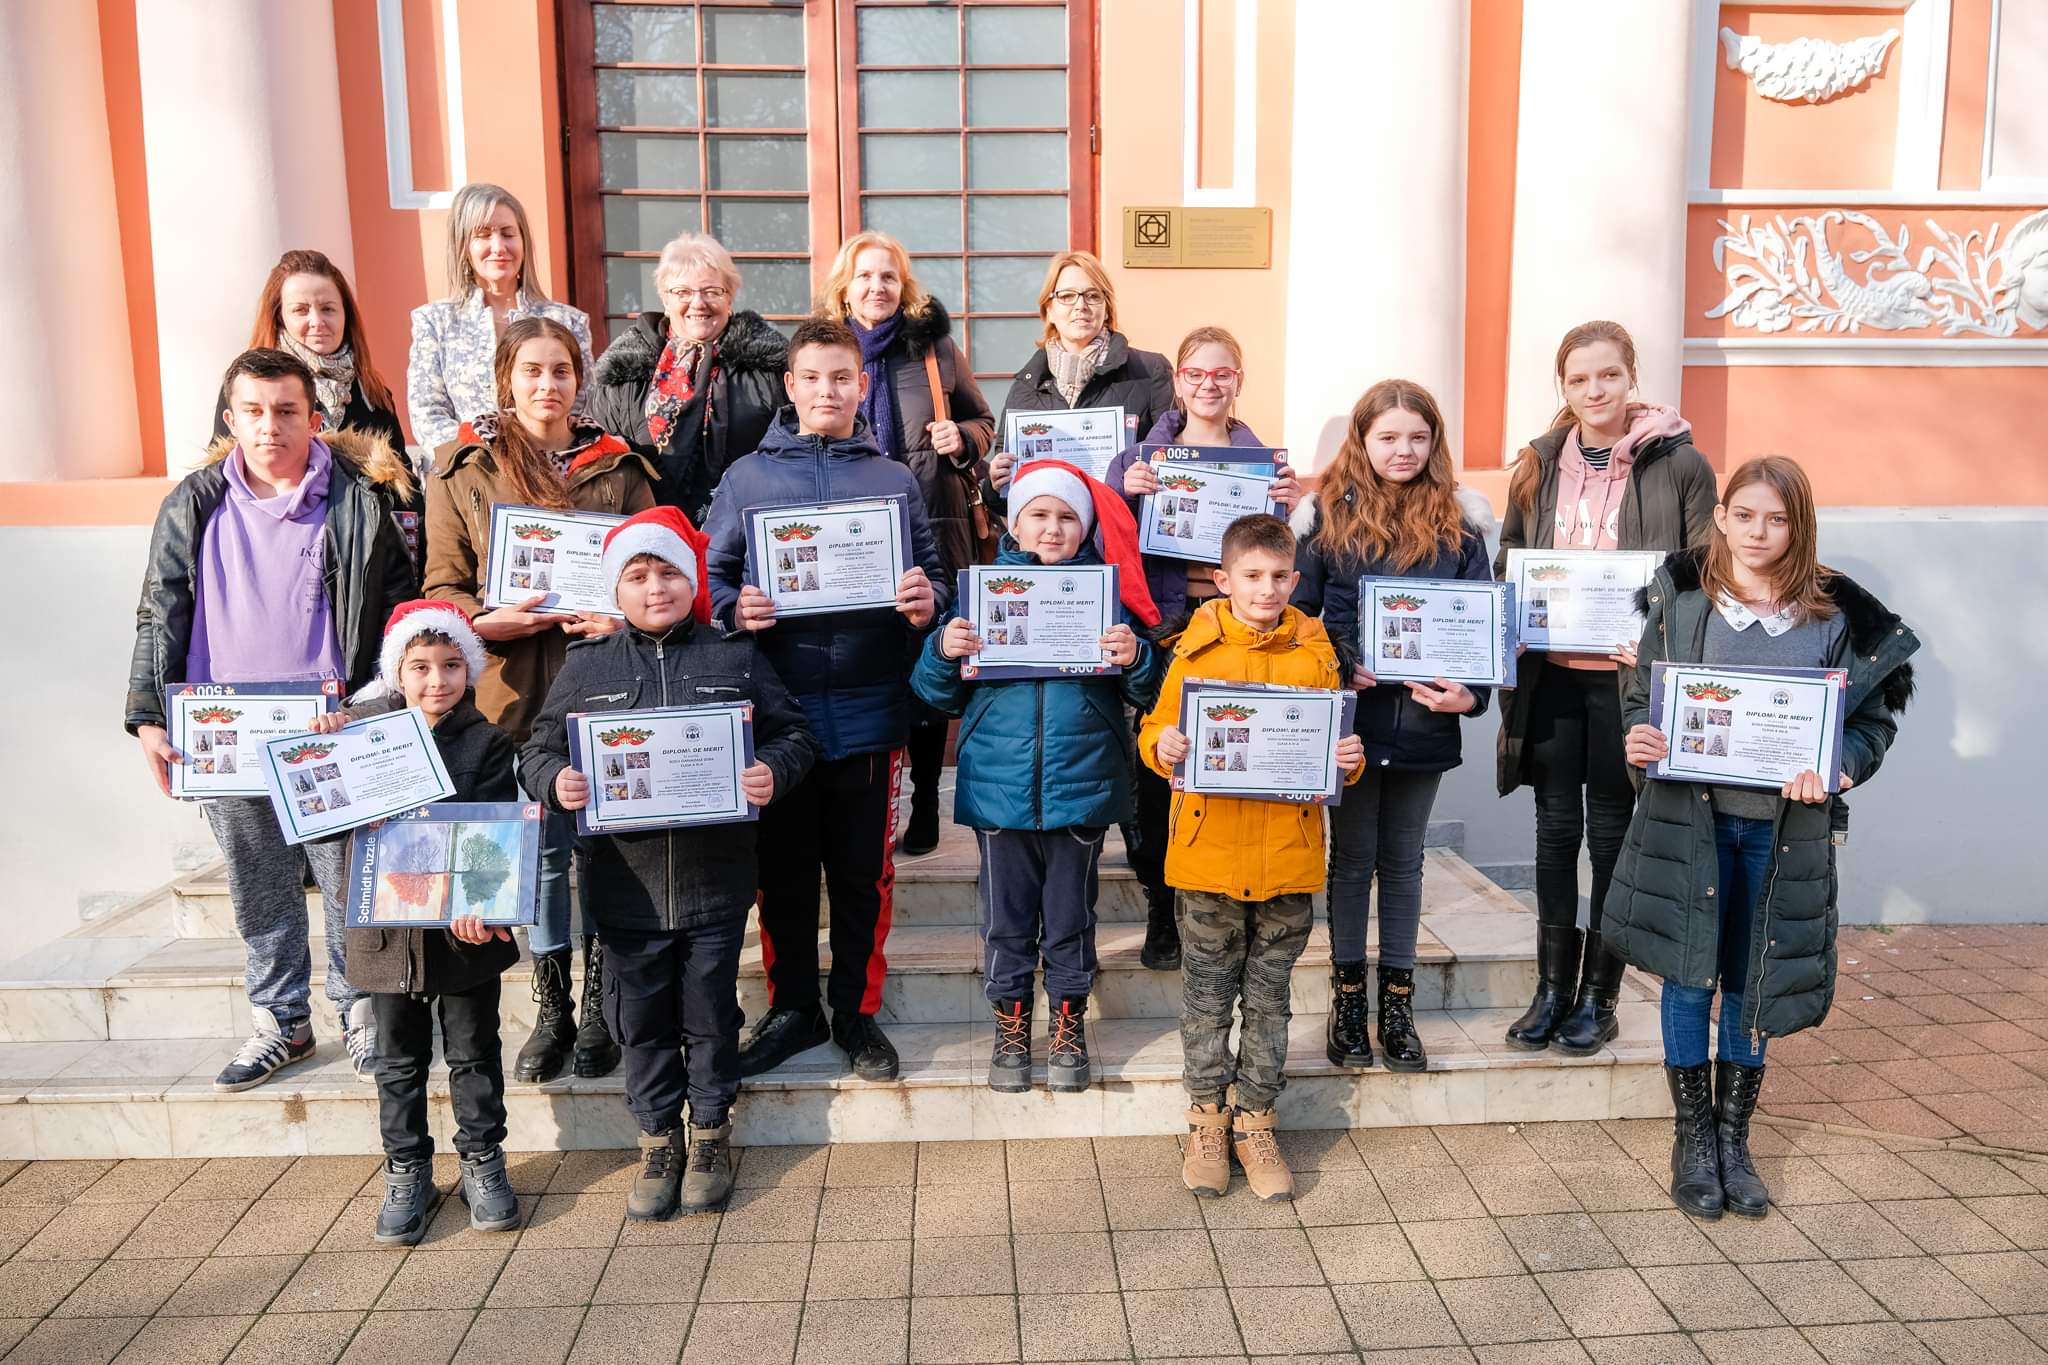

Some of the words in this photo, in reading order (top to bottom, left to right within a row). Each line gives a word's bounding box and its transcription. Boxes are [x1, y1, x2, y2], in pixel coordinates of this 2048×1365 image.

[1167, 448, 1189, 460] 500
[196, 686, 223, 696] 500
[1790, 714, 1814, 722] MERIT
[392, 742, 413, 752] MERIT
[363, 837, 377, 874] Puzzle
[358, 875, 372, 924] Schmidt
